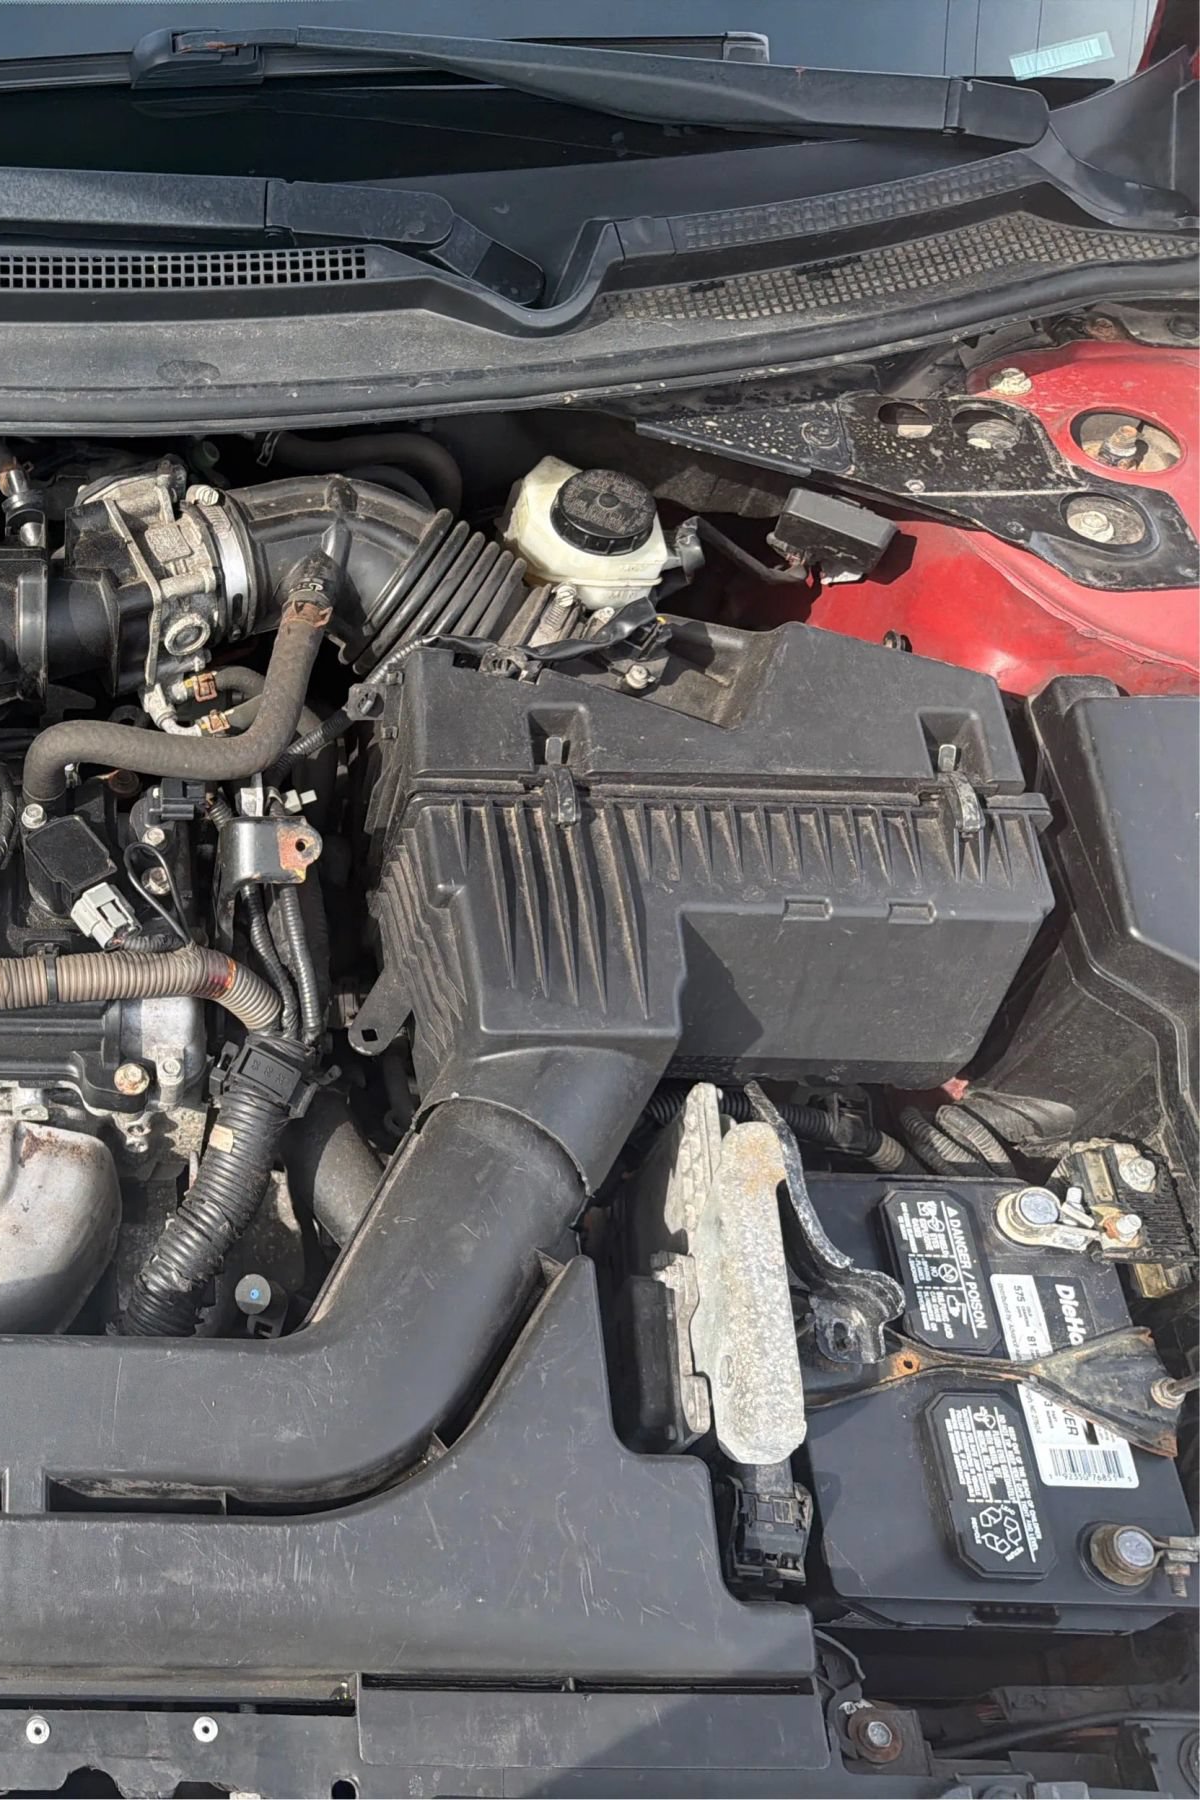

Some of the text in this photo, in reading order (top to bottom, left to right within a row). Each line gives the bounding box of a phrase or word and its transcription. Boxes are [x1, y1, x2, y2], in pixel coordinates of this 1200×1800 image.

[930, 1266, 939, 1277] NO
[950, 1219, 972, 1268] DANGER
[965, 1282, 988, 1329] POISON
[1013, 1285, 1026, 1302] 575
[1054, 1284, 1090, 1345] DieHa
[1026, 1336, 1038, 1346] 81
[1061, 1409, 1080, 1436] VER
[1007, 1426, 1042, 1539] KEEP OUT OF THE REACH OF CHILDREN
[1025, 1520, 1034, 1532] AND
[1028, 1533, 1038, 1550] LEVEL
[1004, 1546, 1024, 1562] RECYCLE
